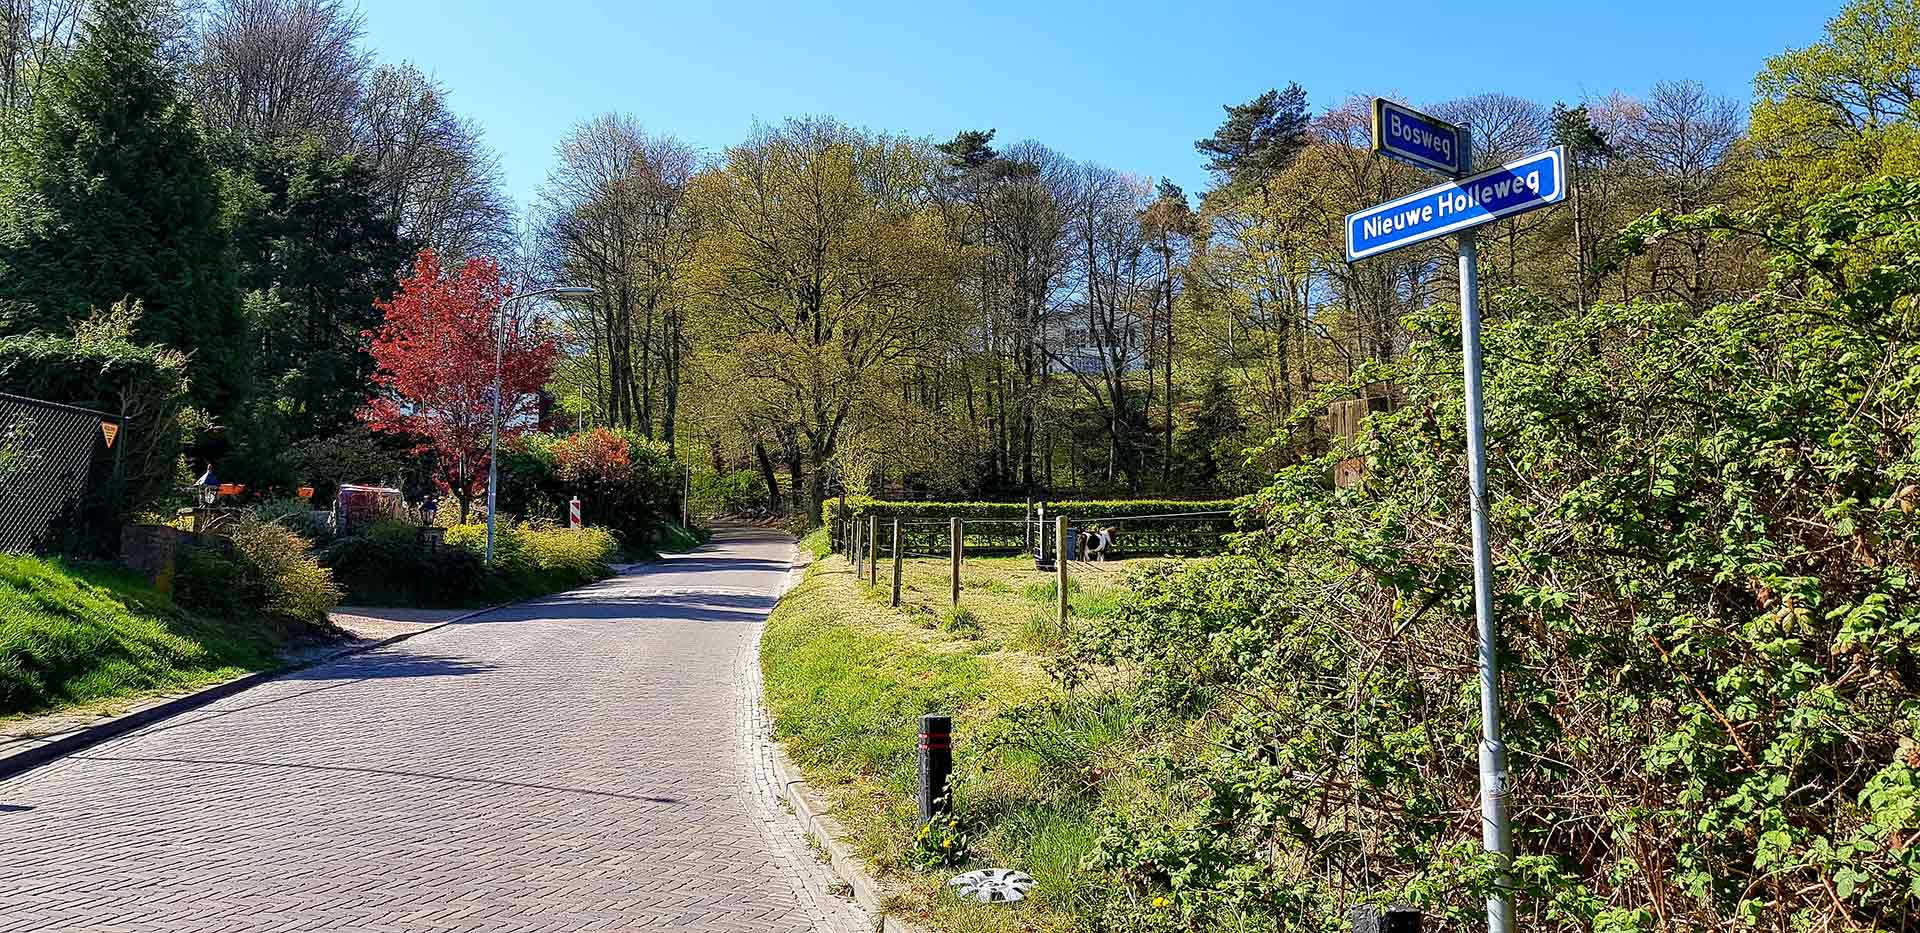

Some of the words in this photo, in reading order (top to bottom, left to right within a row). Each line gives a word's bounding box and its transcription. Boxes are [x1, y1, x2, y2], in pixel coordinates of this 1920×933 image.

[1391, 115, 1451, 160] Bosweg
[1363, 204, 1433, 240] Nieuwe
[1438, 170, 1540, 217] Holleweg
